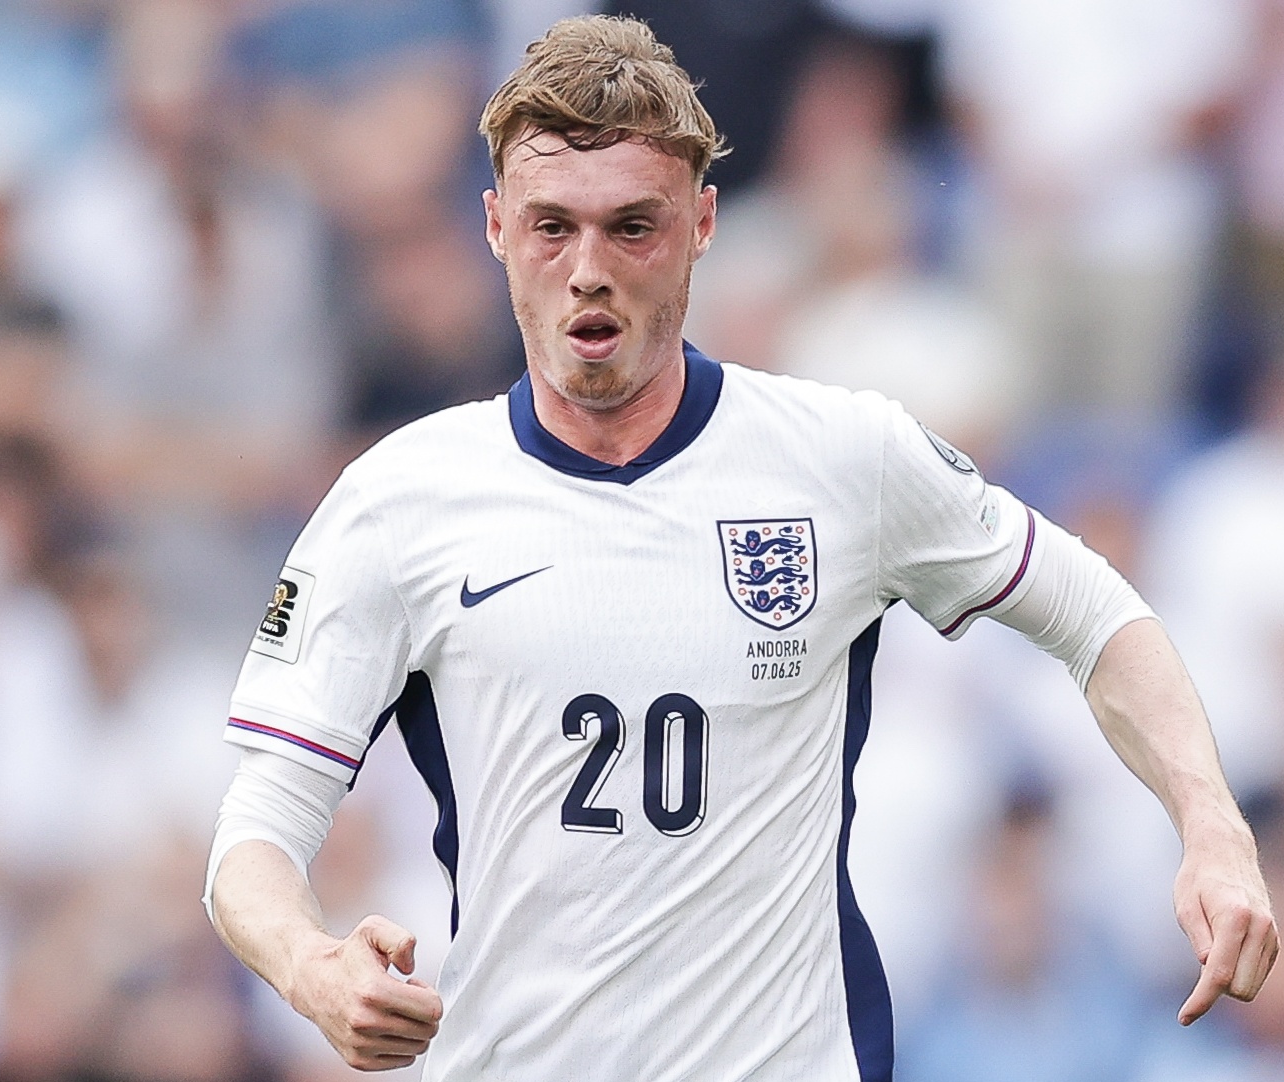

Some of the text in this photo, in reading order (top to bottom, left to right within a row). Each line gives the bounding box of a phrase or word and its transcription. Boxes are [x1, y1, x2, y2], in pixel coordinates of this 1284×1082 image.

[262, 621, 278, 632] FIFA
[746, 639, 808, 658] ANDORRA
[751, 660, 802, 680] 07.06.25
[561, 692, 710, 838] 20
